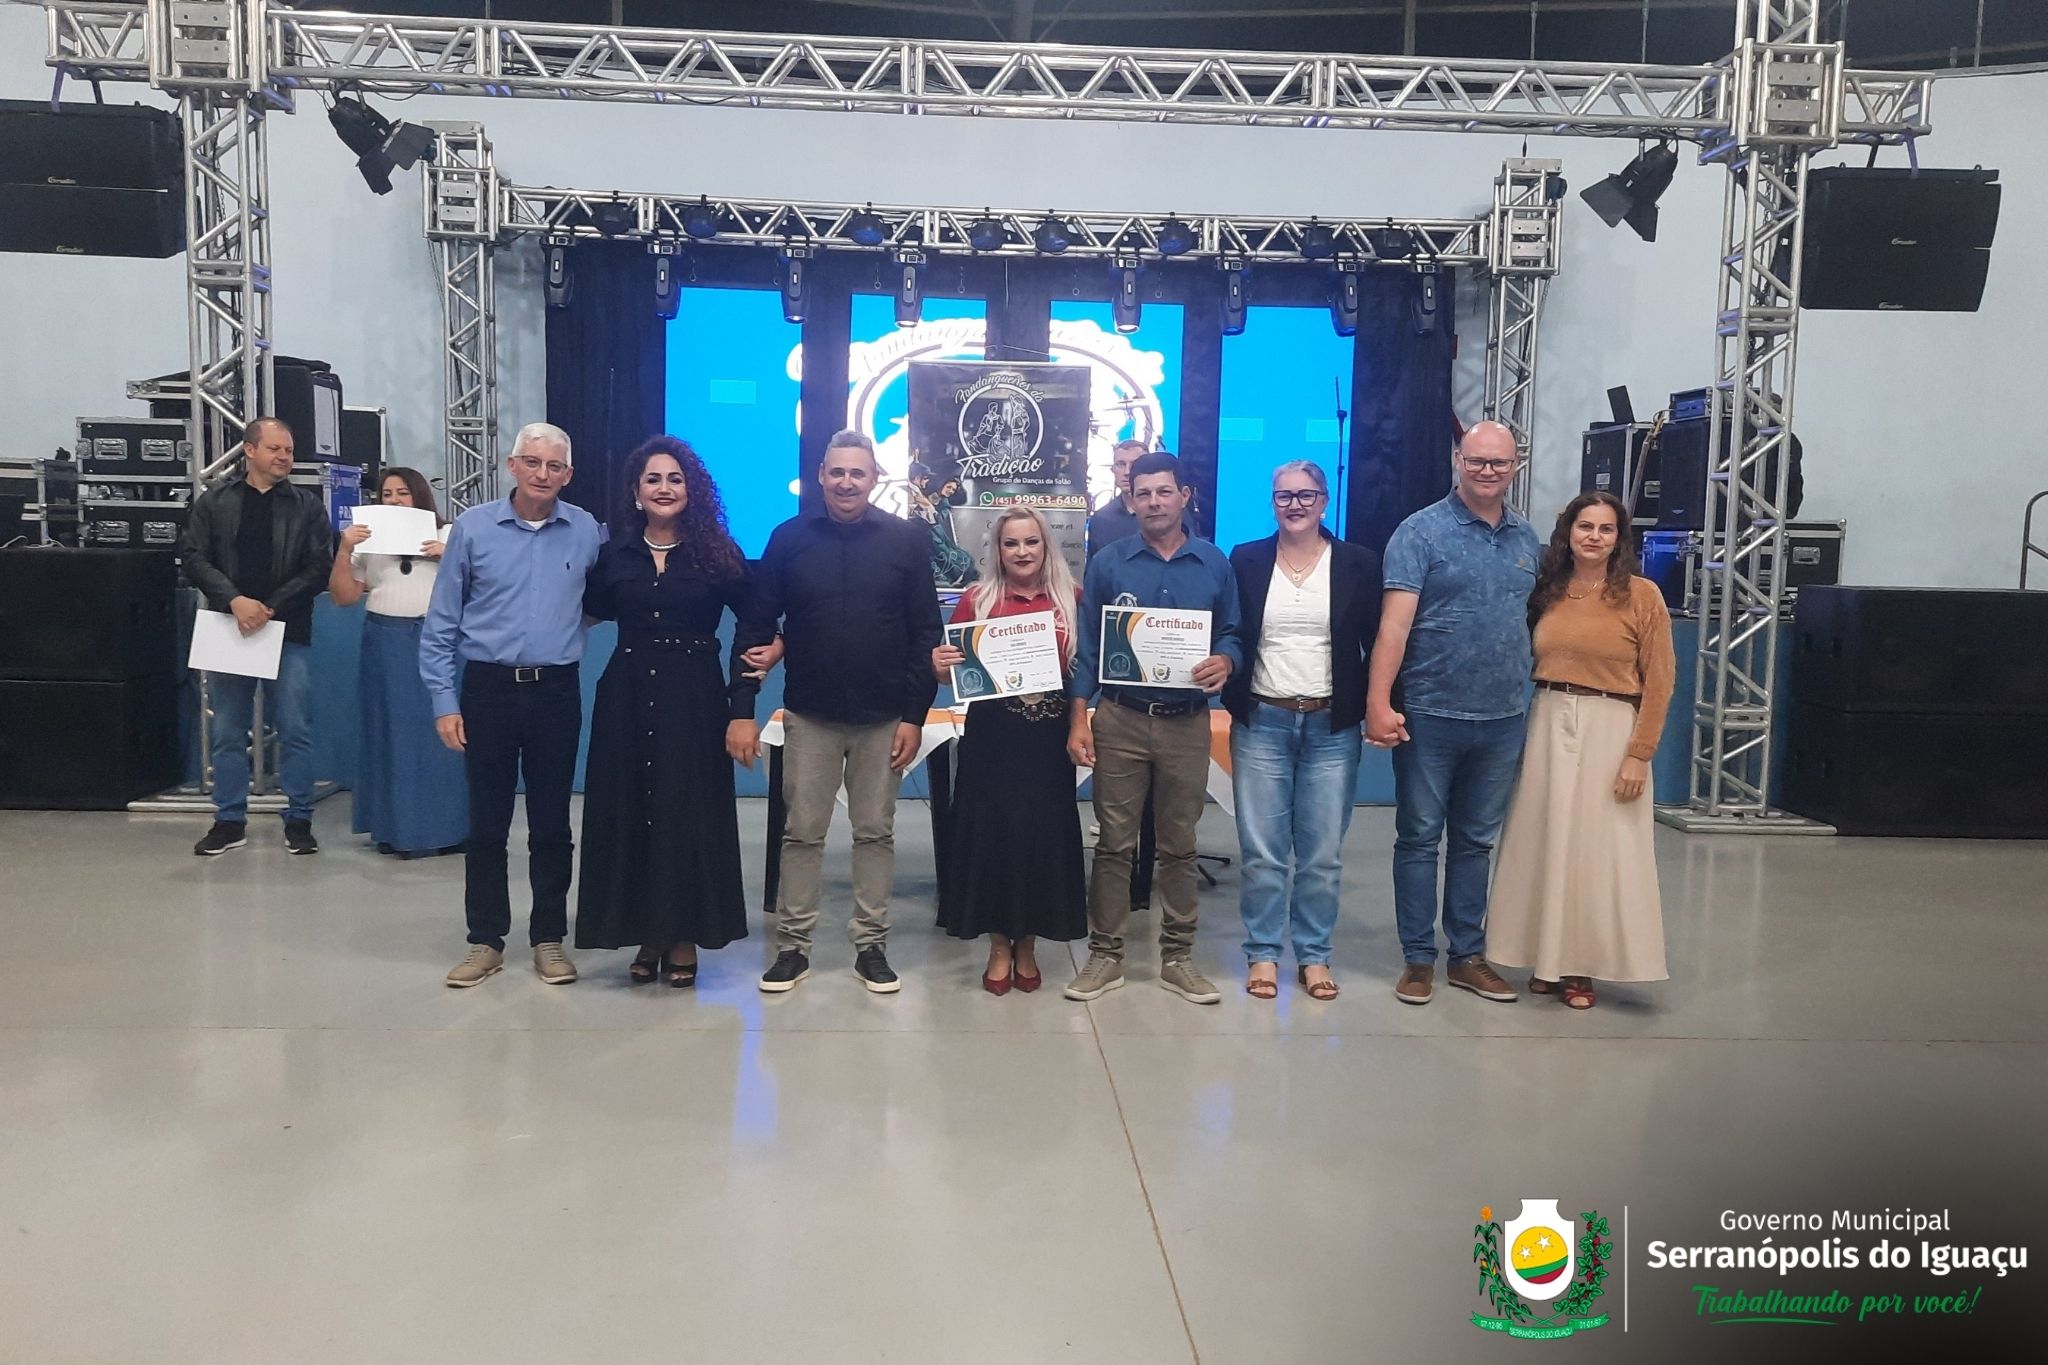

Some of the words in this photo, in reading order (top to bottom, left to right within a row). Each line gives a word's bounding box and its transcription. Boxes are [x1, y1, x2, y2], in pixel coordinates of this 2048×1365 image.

[956, 453, 1044, 481] Tradição
[993, 476, 1012, 484] Grupo
[1022, 477, 1045, 486] Danças
[1054, 477, 1072, 485] Salão
[995, 496, 1012, 505] (45)
[1014, 494, 1086, 506] 99963-6490
[988, 622, 1047, 639] Certificado
[1145, 616, 1204, 631] Certificado
